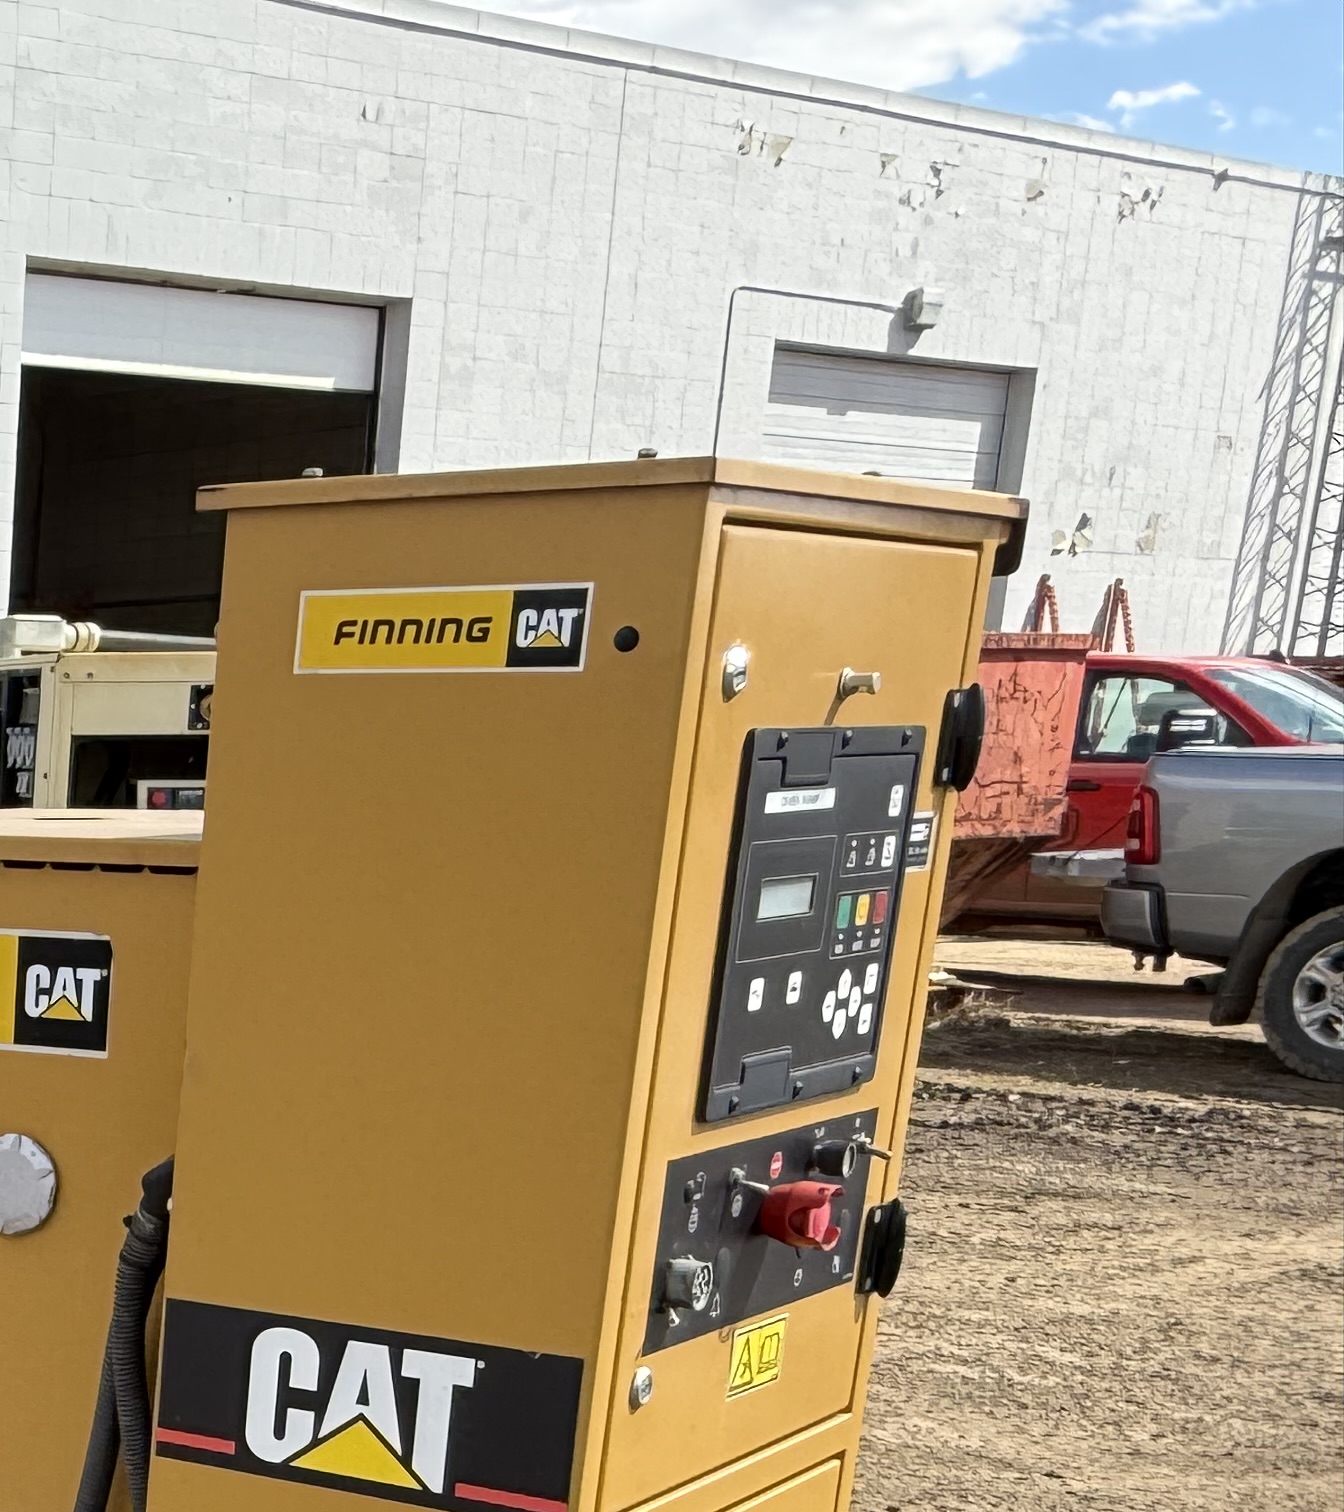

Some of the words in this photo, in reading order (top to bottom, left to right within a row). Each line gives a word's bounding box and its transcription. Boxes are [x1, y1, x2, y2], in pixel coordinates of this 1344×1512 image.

[333, 615, 493, 646] FINNING
[515, 607, 581, 649] CAT
[24, 964, 102, 1022] CAT
[244, 1326, 477, 1494] CAT
